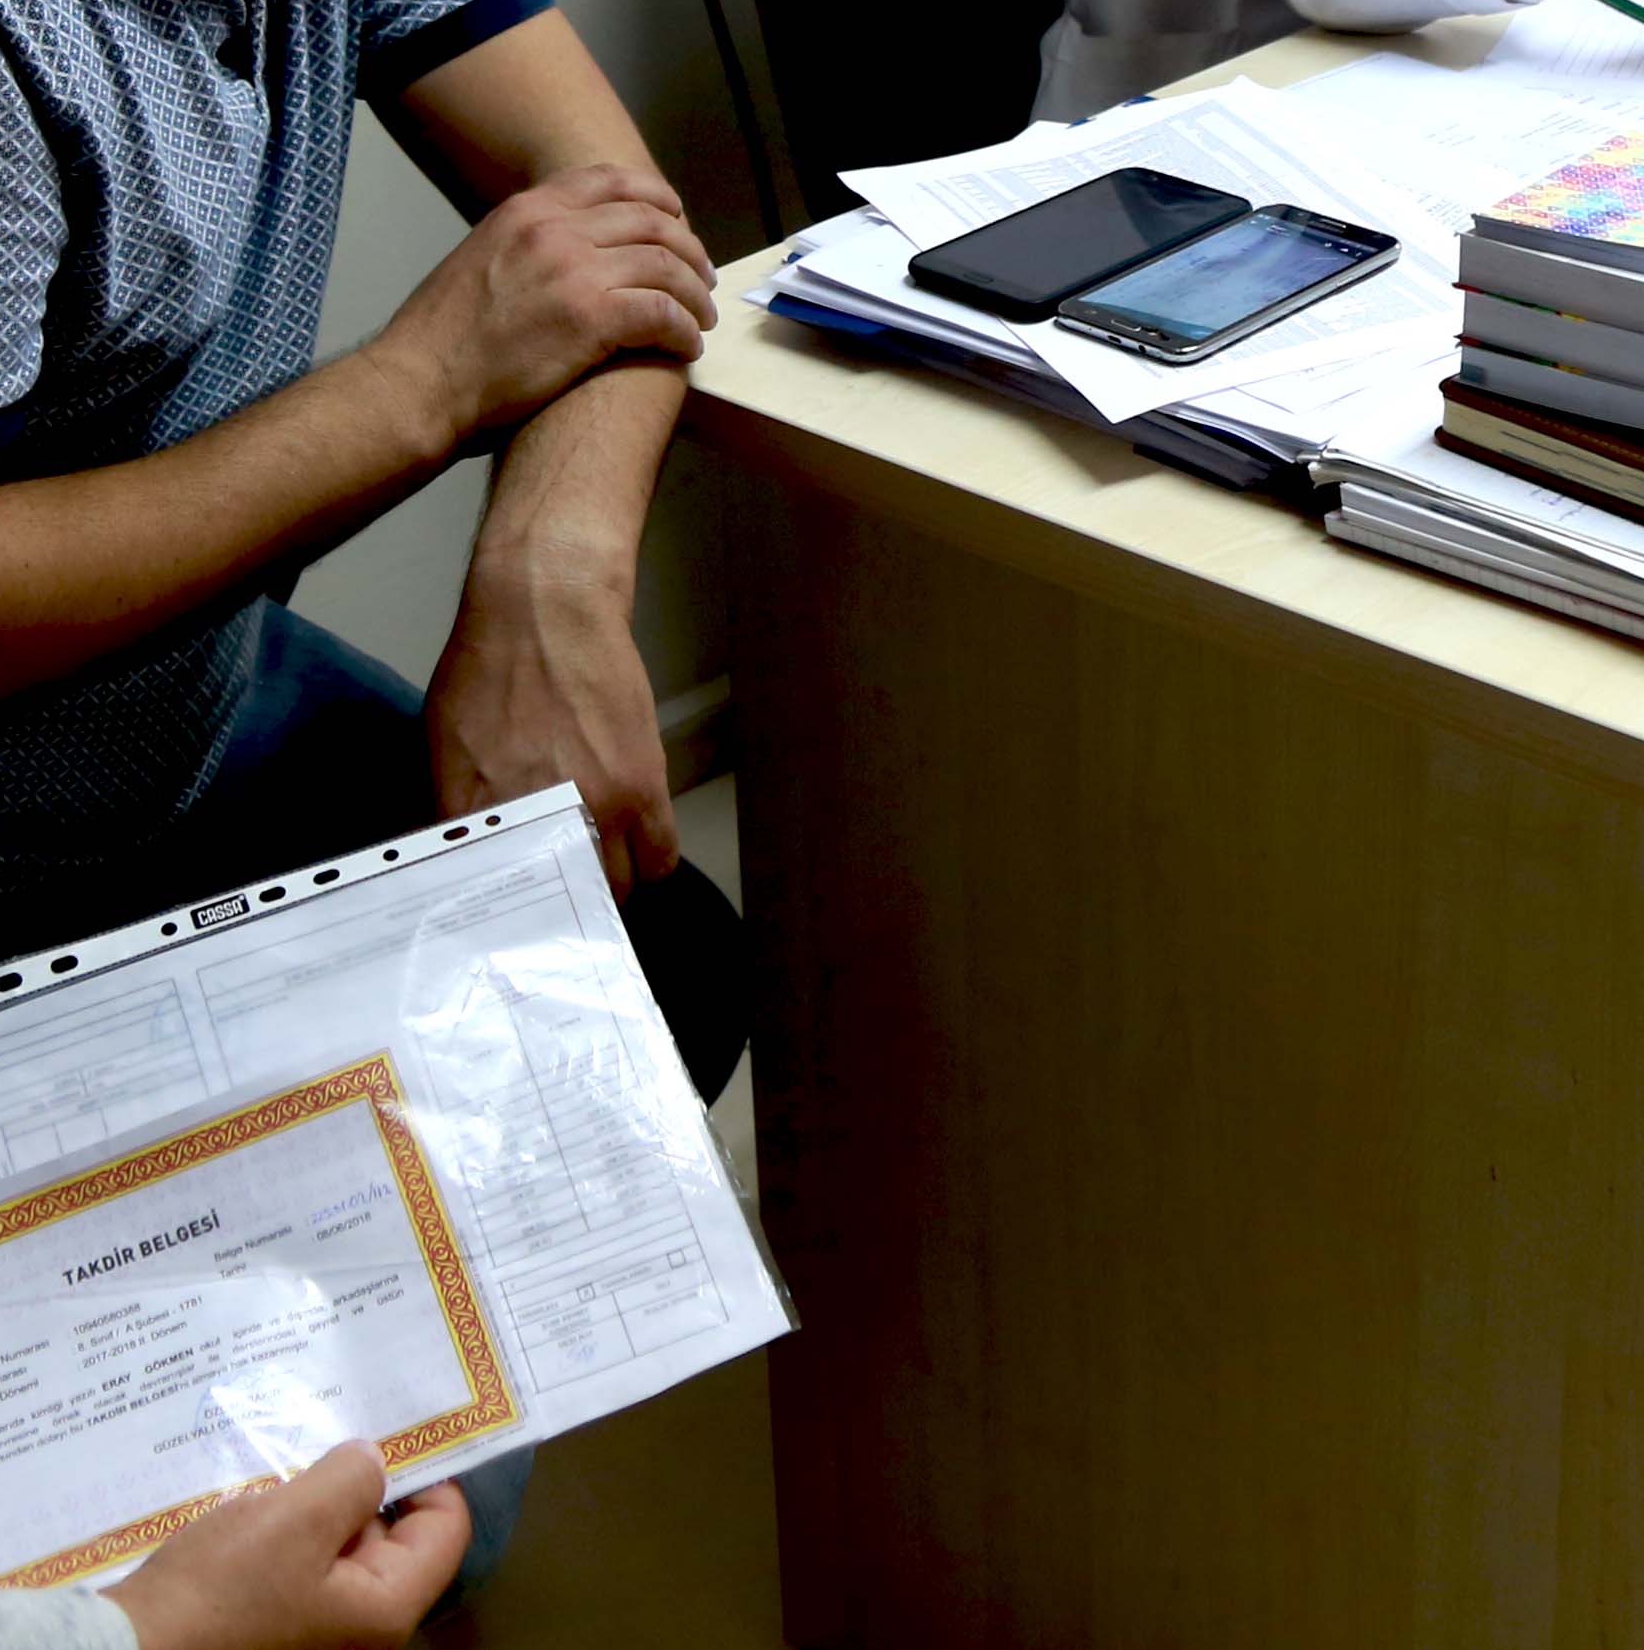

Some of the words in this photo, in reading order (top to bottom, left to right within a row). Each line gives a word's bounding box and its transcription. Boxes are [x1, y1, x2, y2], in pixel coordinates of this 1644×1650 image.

[197, 899, 243, 926] CASSA
[62, 1245, 136, 1287] TAKDİR
[139, 1209, 221, 1258] BELGESİ
[80, 1339, 139, 1370] 2017-2018
[99, 1371, 133, 1392] ERAY
[142, 1345, 196, 1374] GÖKMEN
[84, 1402, 129, 1428] TAKDİR
[151, 1422, 217, 1456] GÜZELYALI
